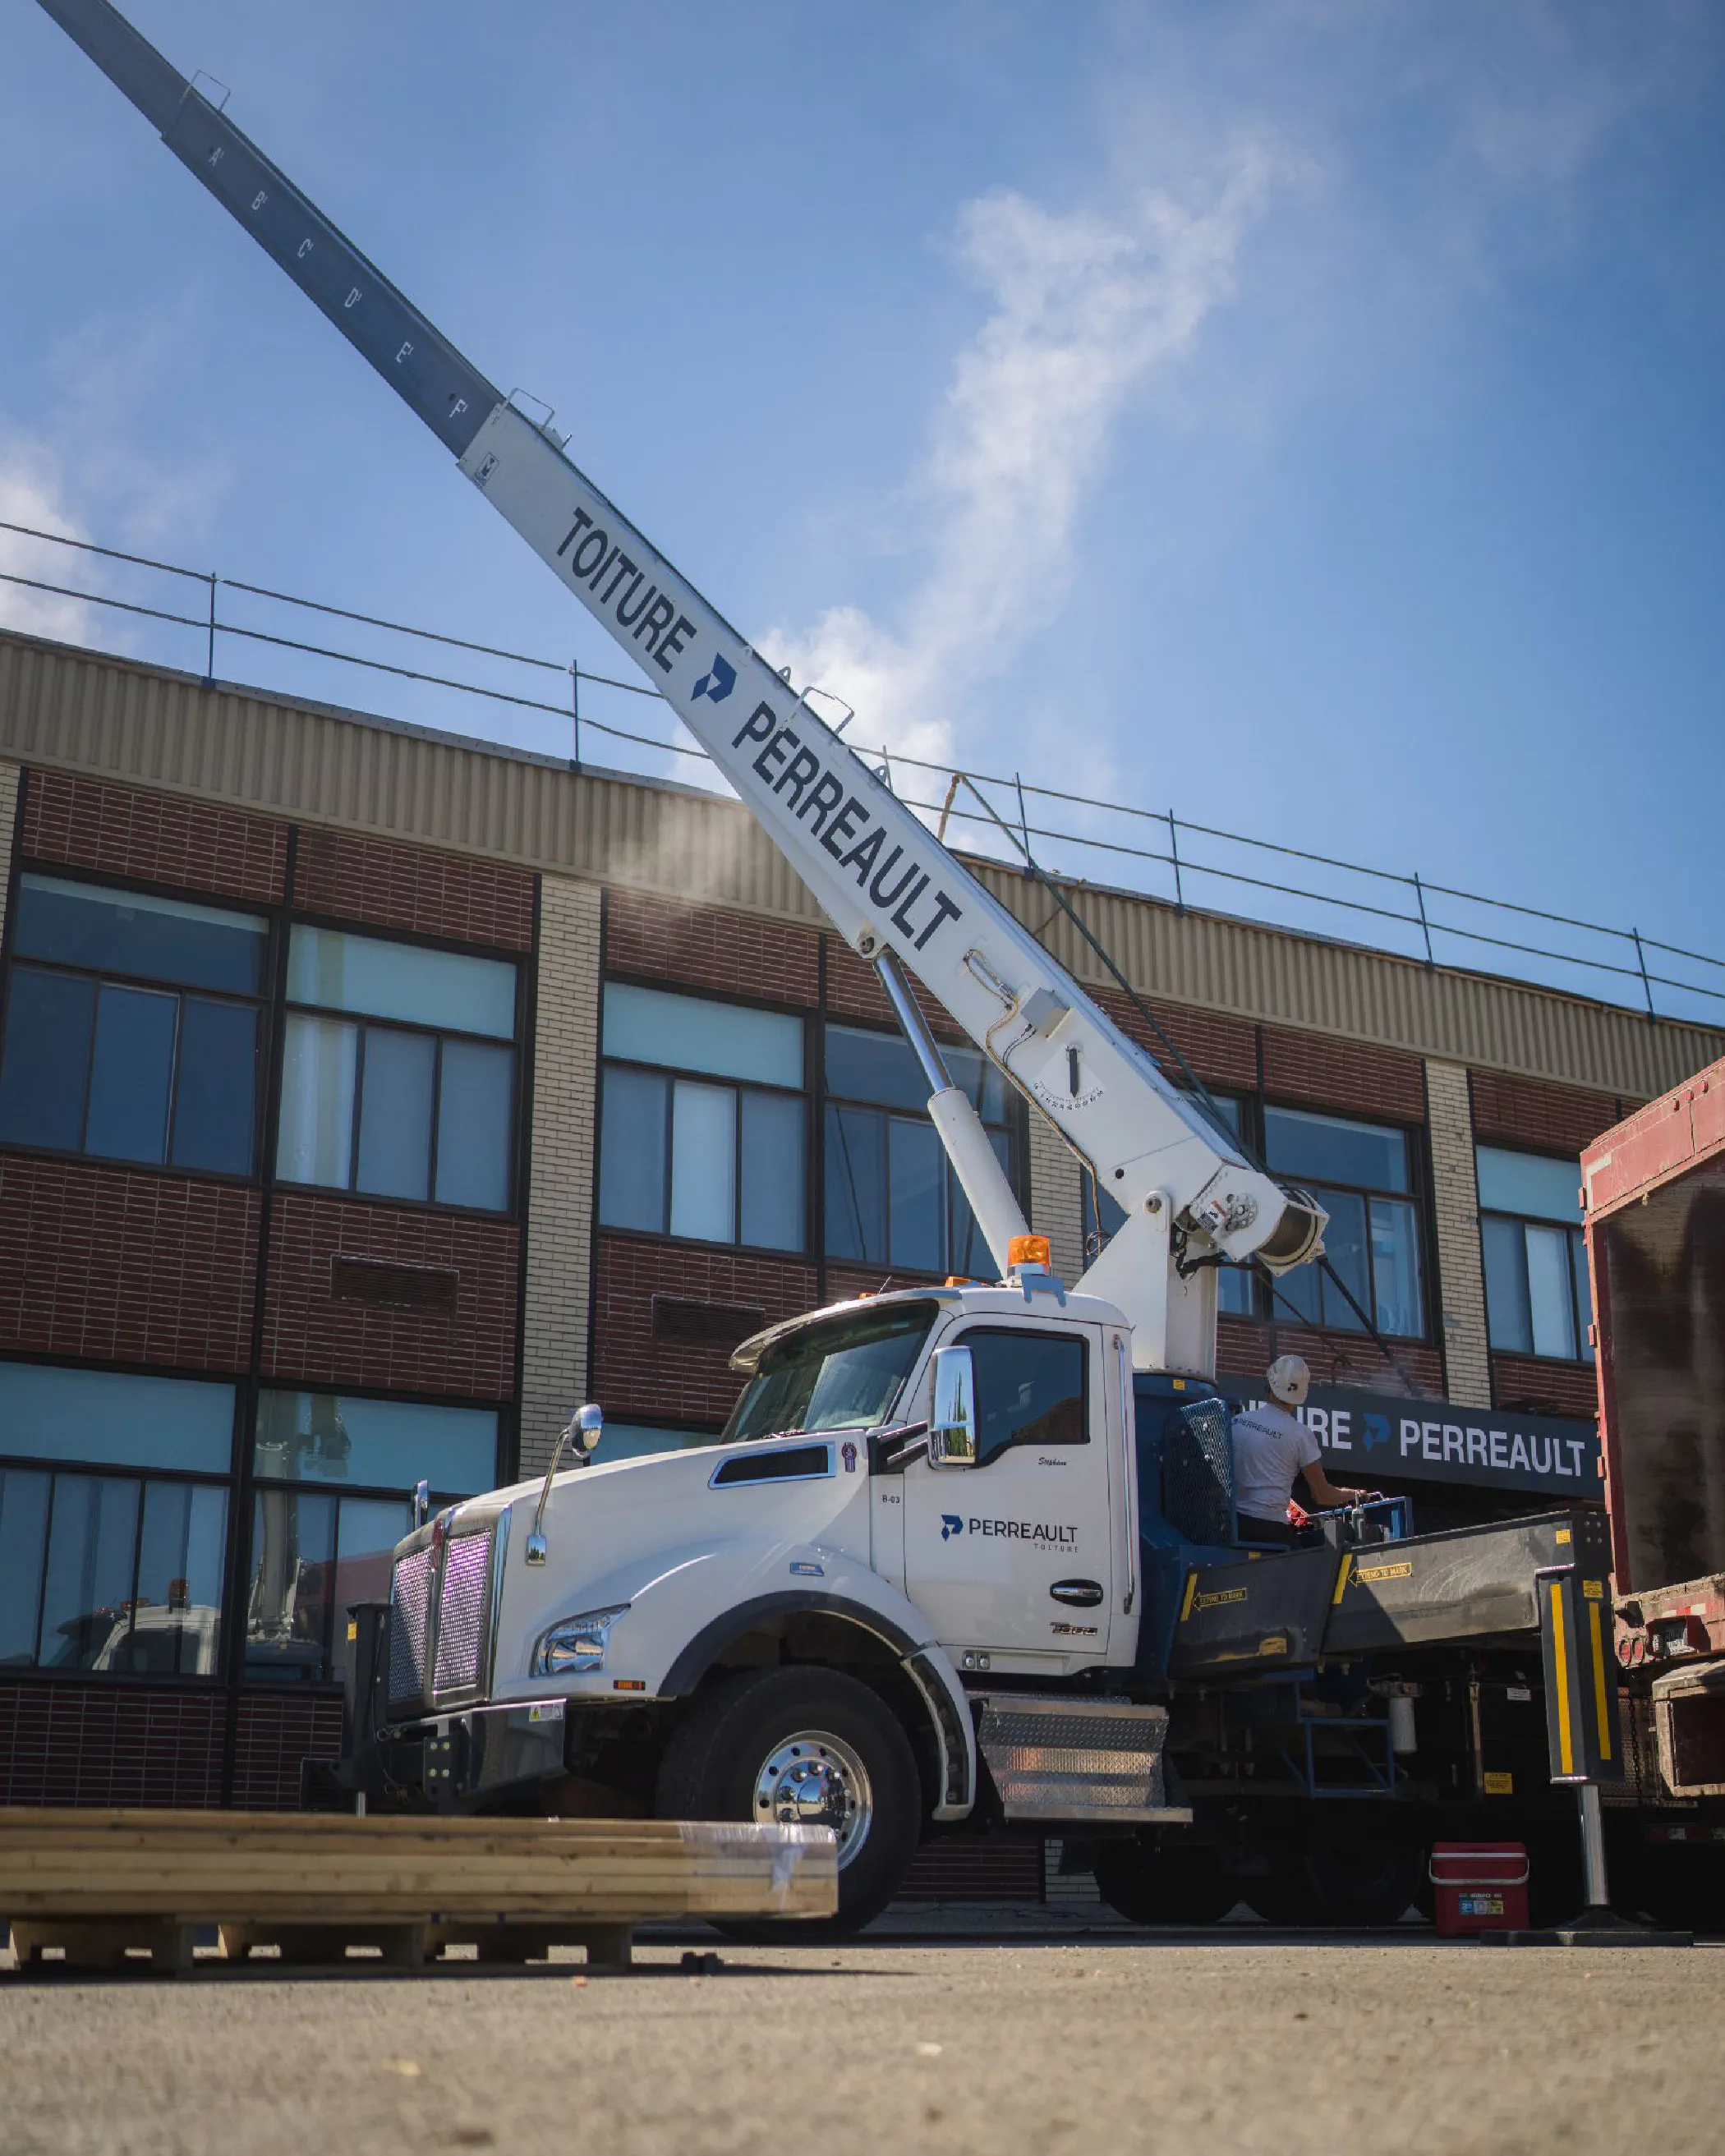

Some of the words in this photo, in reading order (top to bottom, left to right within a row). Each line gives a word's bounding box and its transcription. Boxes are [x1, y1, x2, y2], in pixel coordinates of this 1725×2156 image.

[557, 507, 697, 673] TOITURE
[731, 701, 963, 951] PERREAULT
[1238, 1418, 1284, 1440] PERREAULT
[1400, 1418, 1585, 1477] PERREAULT
[968, 1518, 1079, 1542] PERREAULT
[1033, 1543, 1079, 1553] TOITURE
[1390, 1565, 1408, 1575] MARK
